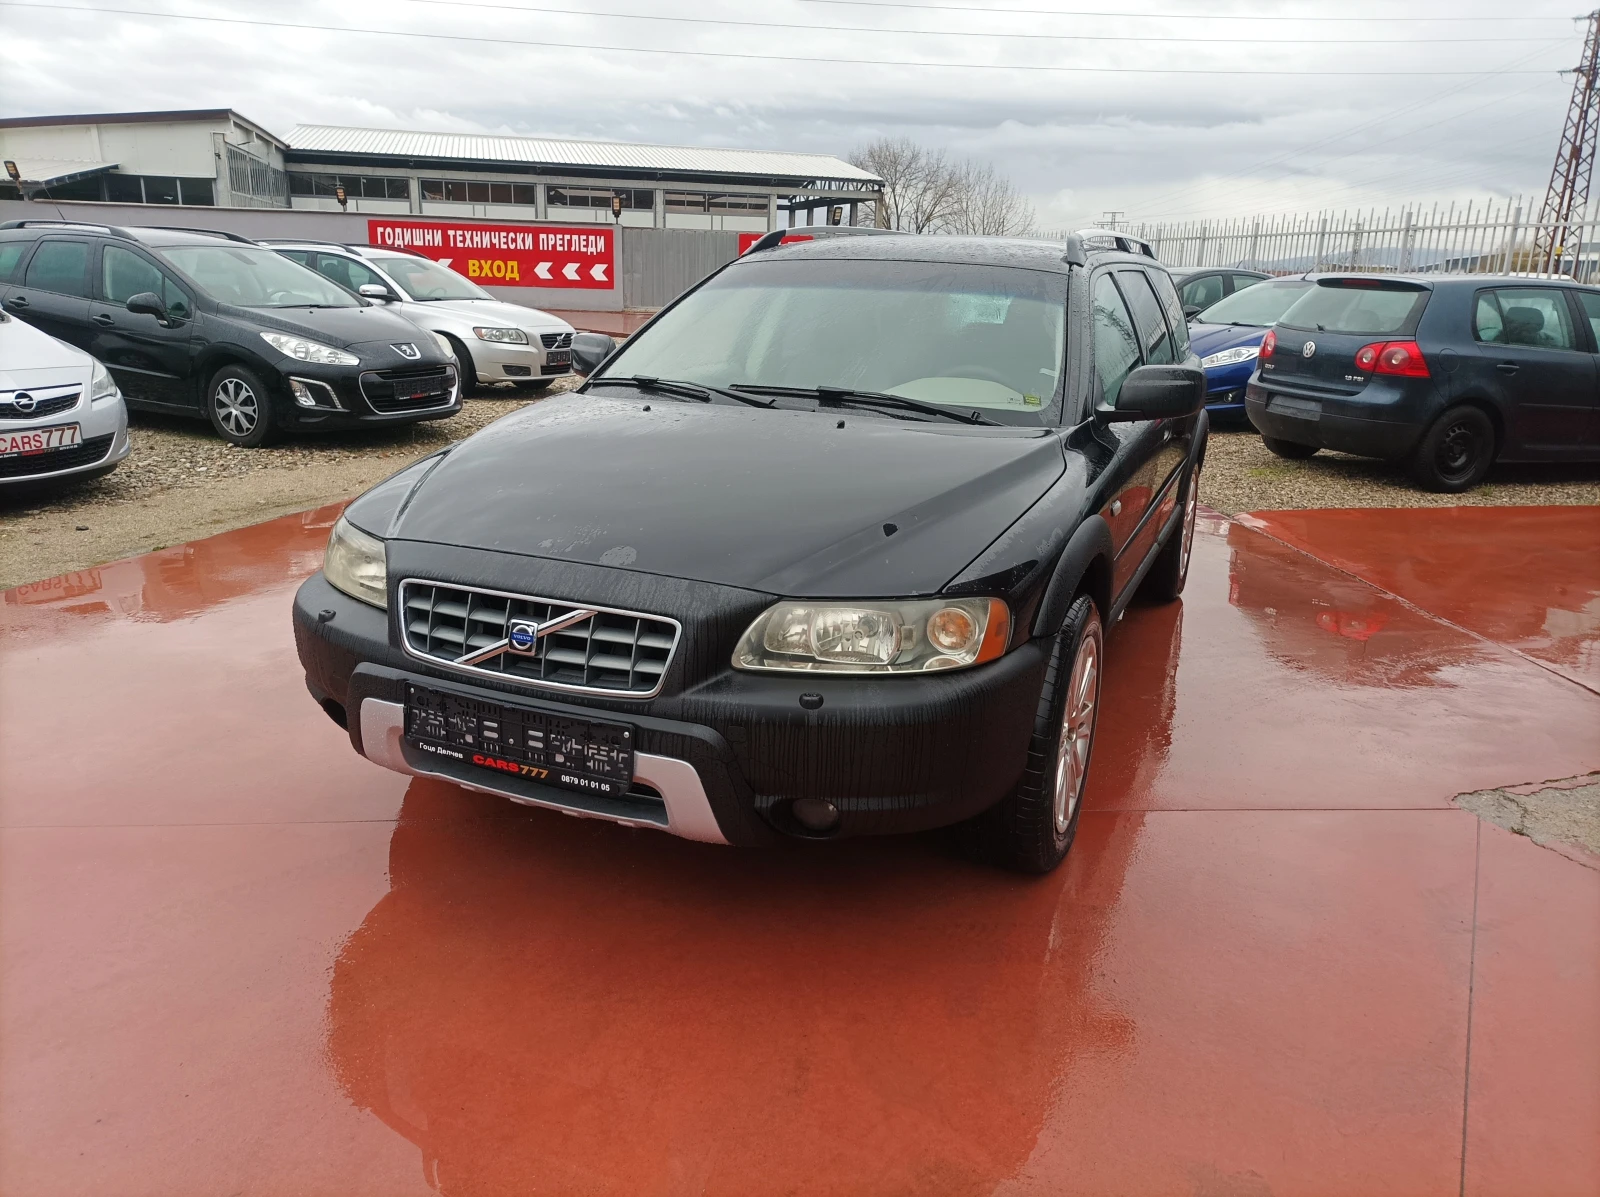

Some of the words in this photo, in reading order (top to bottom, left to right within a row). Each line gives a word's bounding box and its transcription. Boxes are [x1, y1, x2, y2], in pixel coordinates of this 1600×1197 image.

[376, 227, 442, 248] ГОДИШНИ
[447, 230, 533, 250] ТЕХНИЧЕСКИ
[539, 233, 605, 255] ПРЕГЛЕДИ
[468, 260, 520, 281] ВХОД
[419, 742, 436, 752] Гоце
[437, 746, 464, 759] Делчев
[472, 753, 549, 779] CARS777
[561, 774, 579, 785] 0879
[580, 778, 588, 787] 01
[590, 781, 599, 789] 01
[601, 783, 610, 792] 05
